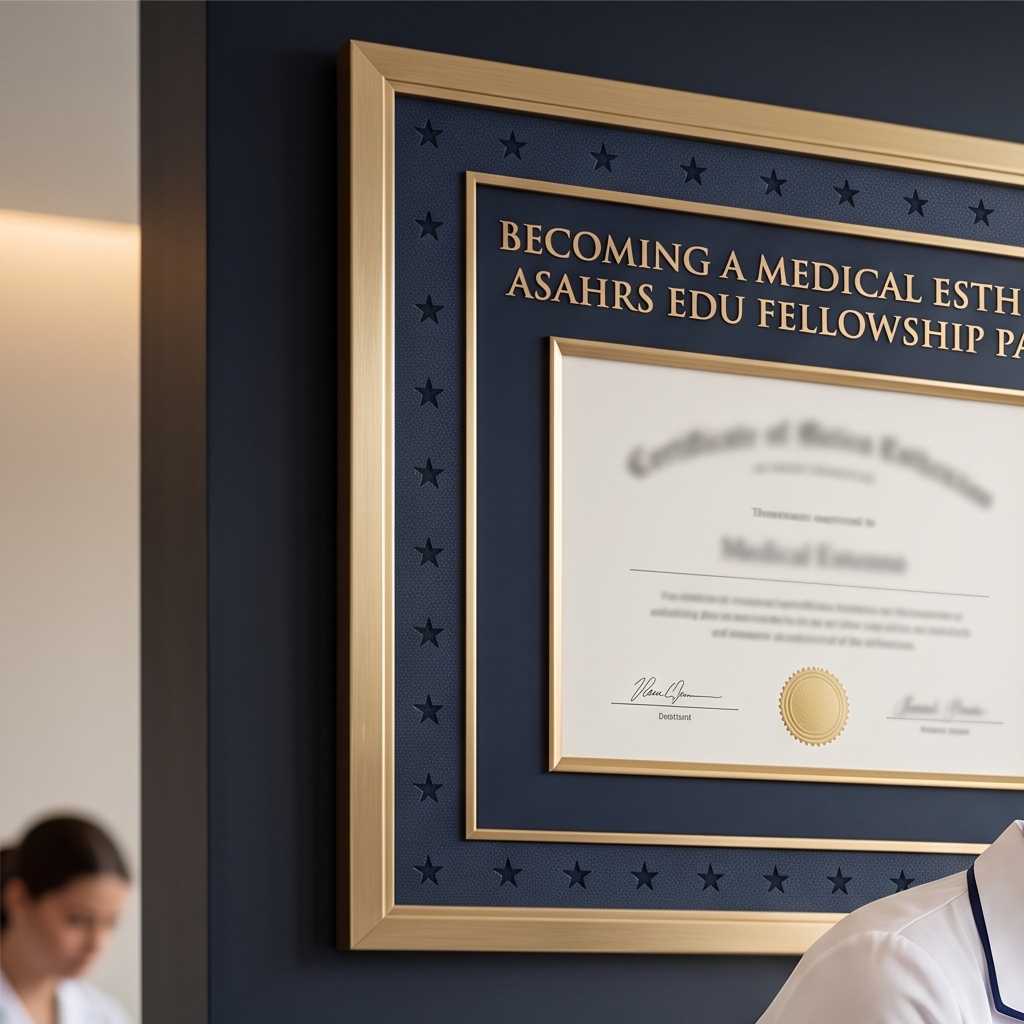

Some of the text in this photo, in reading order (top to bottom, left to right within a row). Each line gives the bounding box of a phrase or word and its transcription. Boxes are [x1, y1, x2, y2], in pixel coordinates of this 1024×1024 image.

[499, 219, 711, 277] BECOMING
[718, 250, 748, 282] A
[755, 253, 923, 304] MEDICAL
[504, 267, 654, 314] ASAHRS
[667, 286, 746, 325] EDU
[757, 298, 985, 354] FELLOWSHIP
